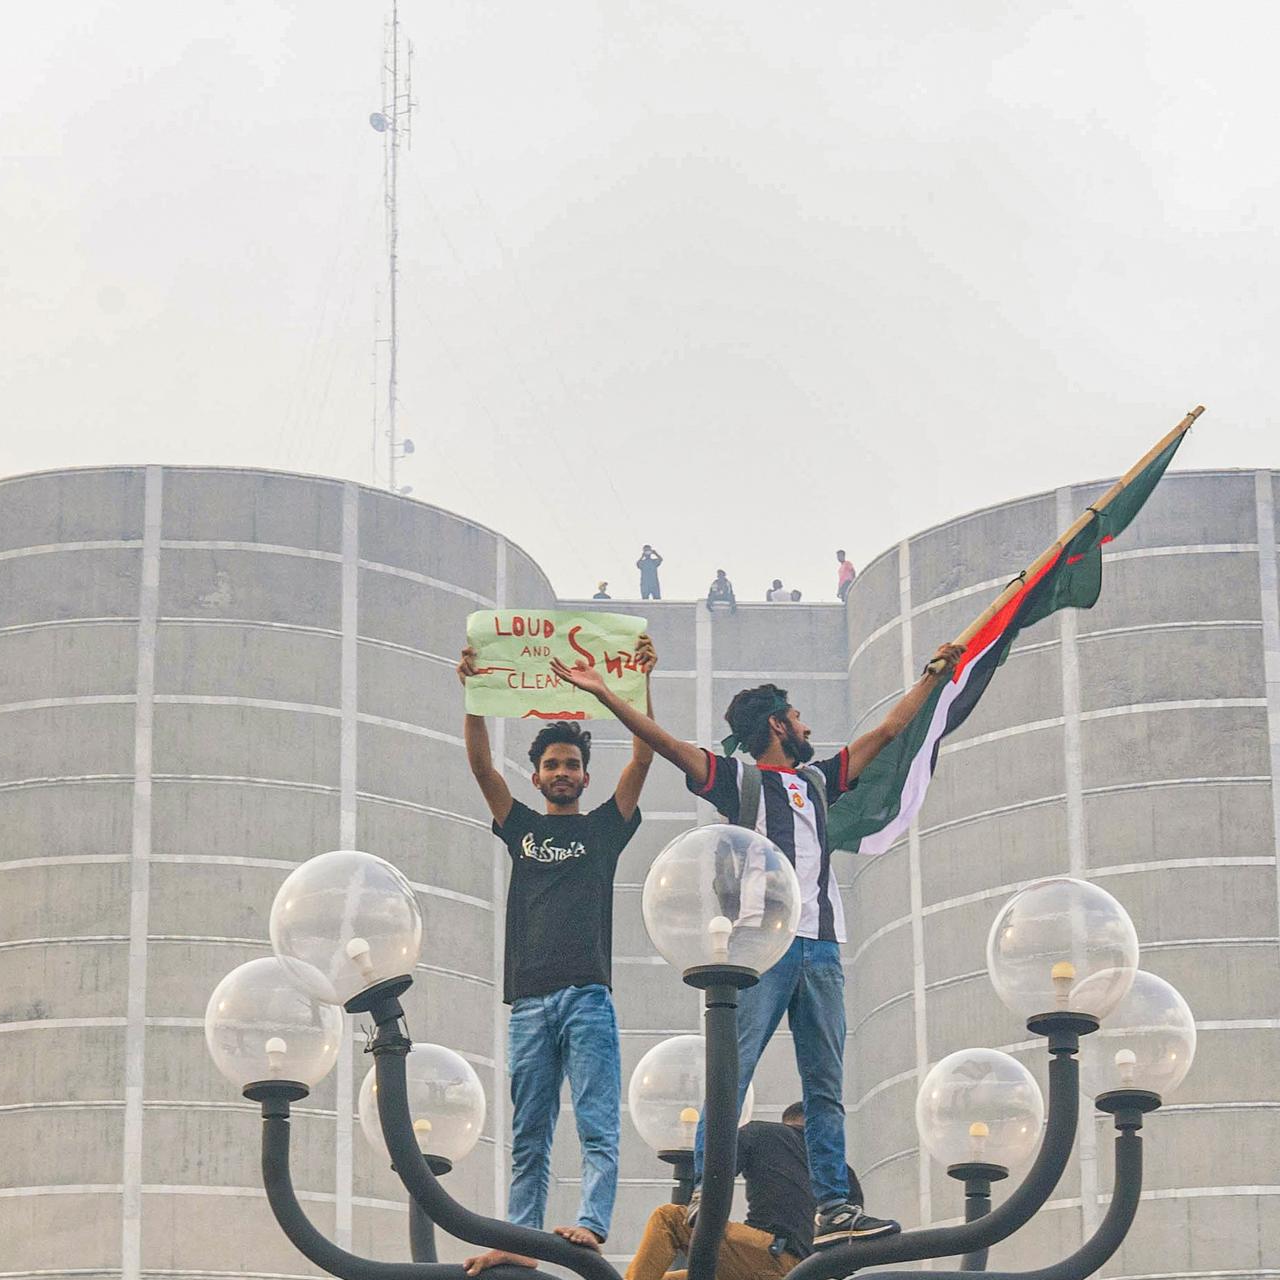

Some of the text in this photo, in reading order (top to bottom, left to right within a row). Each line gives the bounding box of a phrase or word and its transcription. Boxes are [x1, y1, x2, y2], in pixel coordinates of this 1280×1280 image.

[495, 616, 555, 639] LOUD
[520, 645, 551, 657] AND
[507, 671, 564, 690] CLEAR
